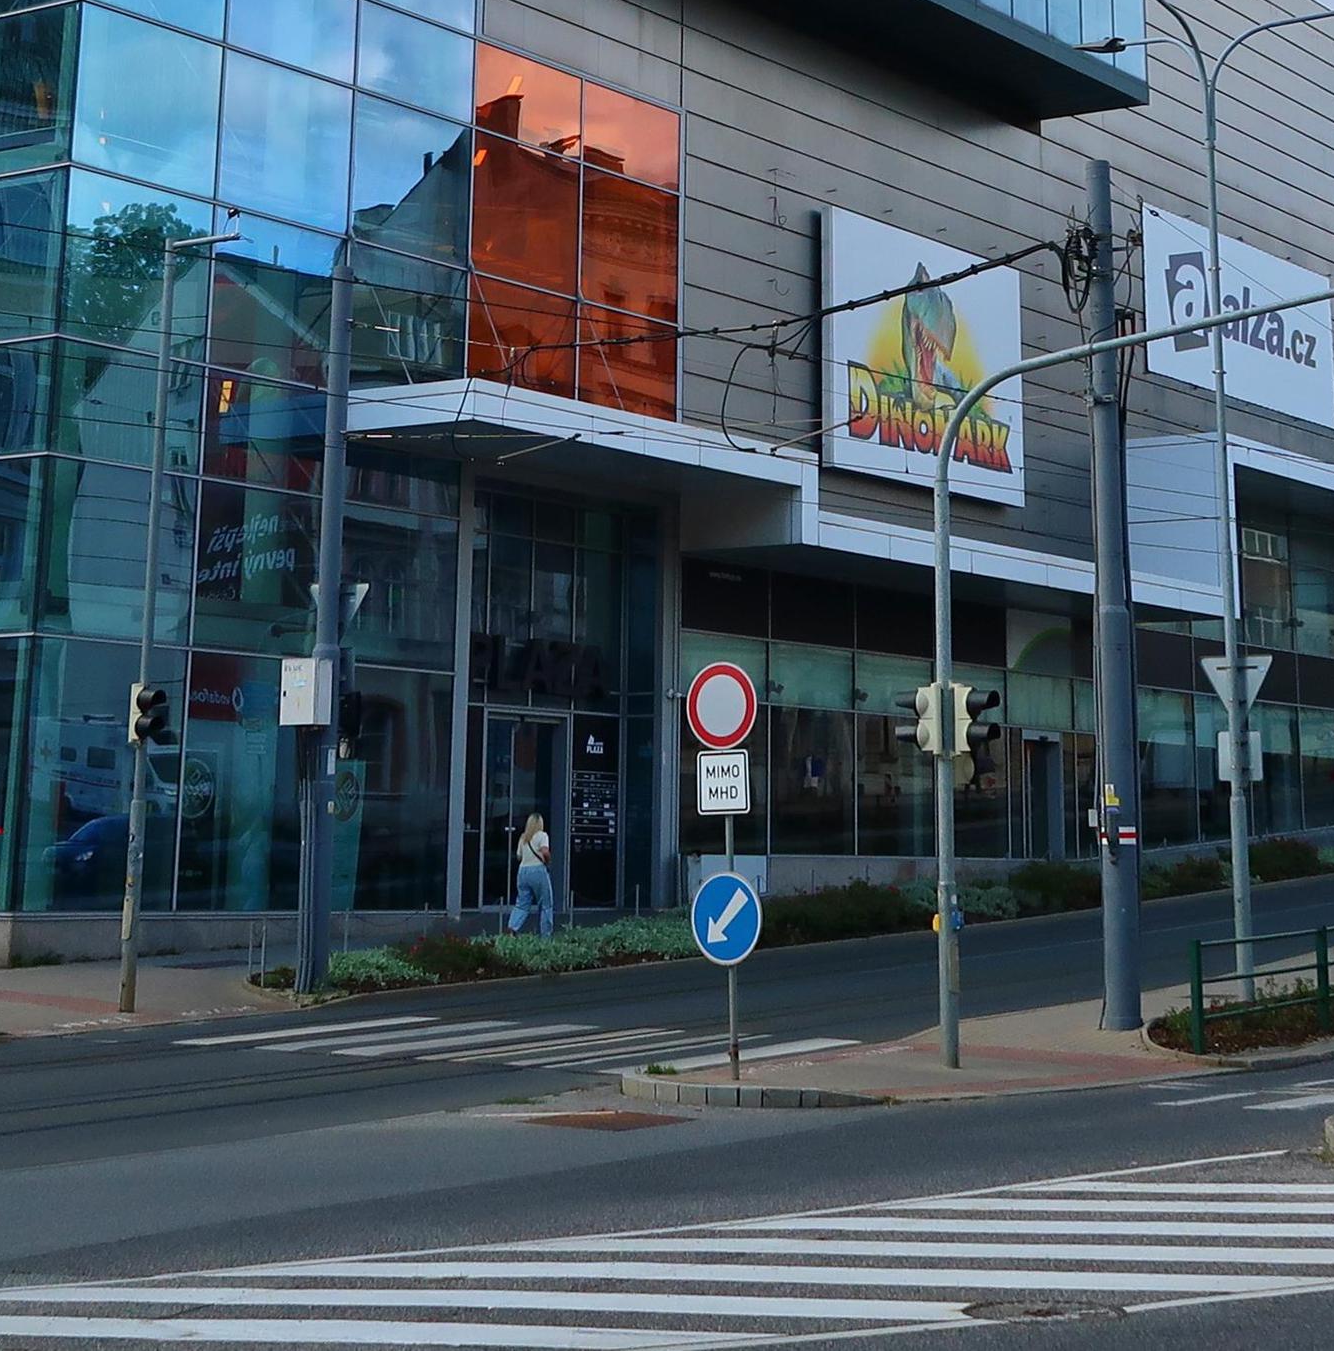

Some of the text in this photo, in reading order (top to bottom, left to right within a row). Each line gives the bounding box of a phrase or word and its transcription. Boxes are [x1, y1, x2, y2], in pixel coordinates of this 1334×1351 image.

[1220, 286, 1317, 369] alza.cz
[706, 764, 740, 779] MIMO
[708, 785, 738, 800] MHD
